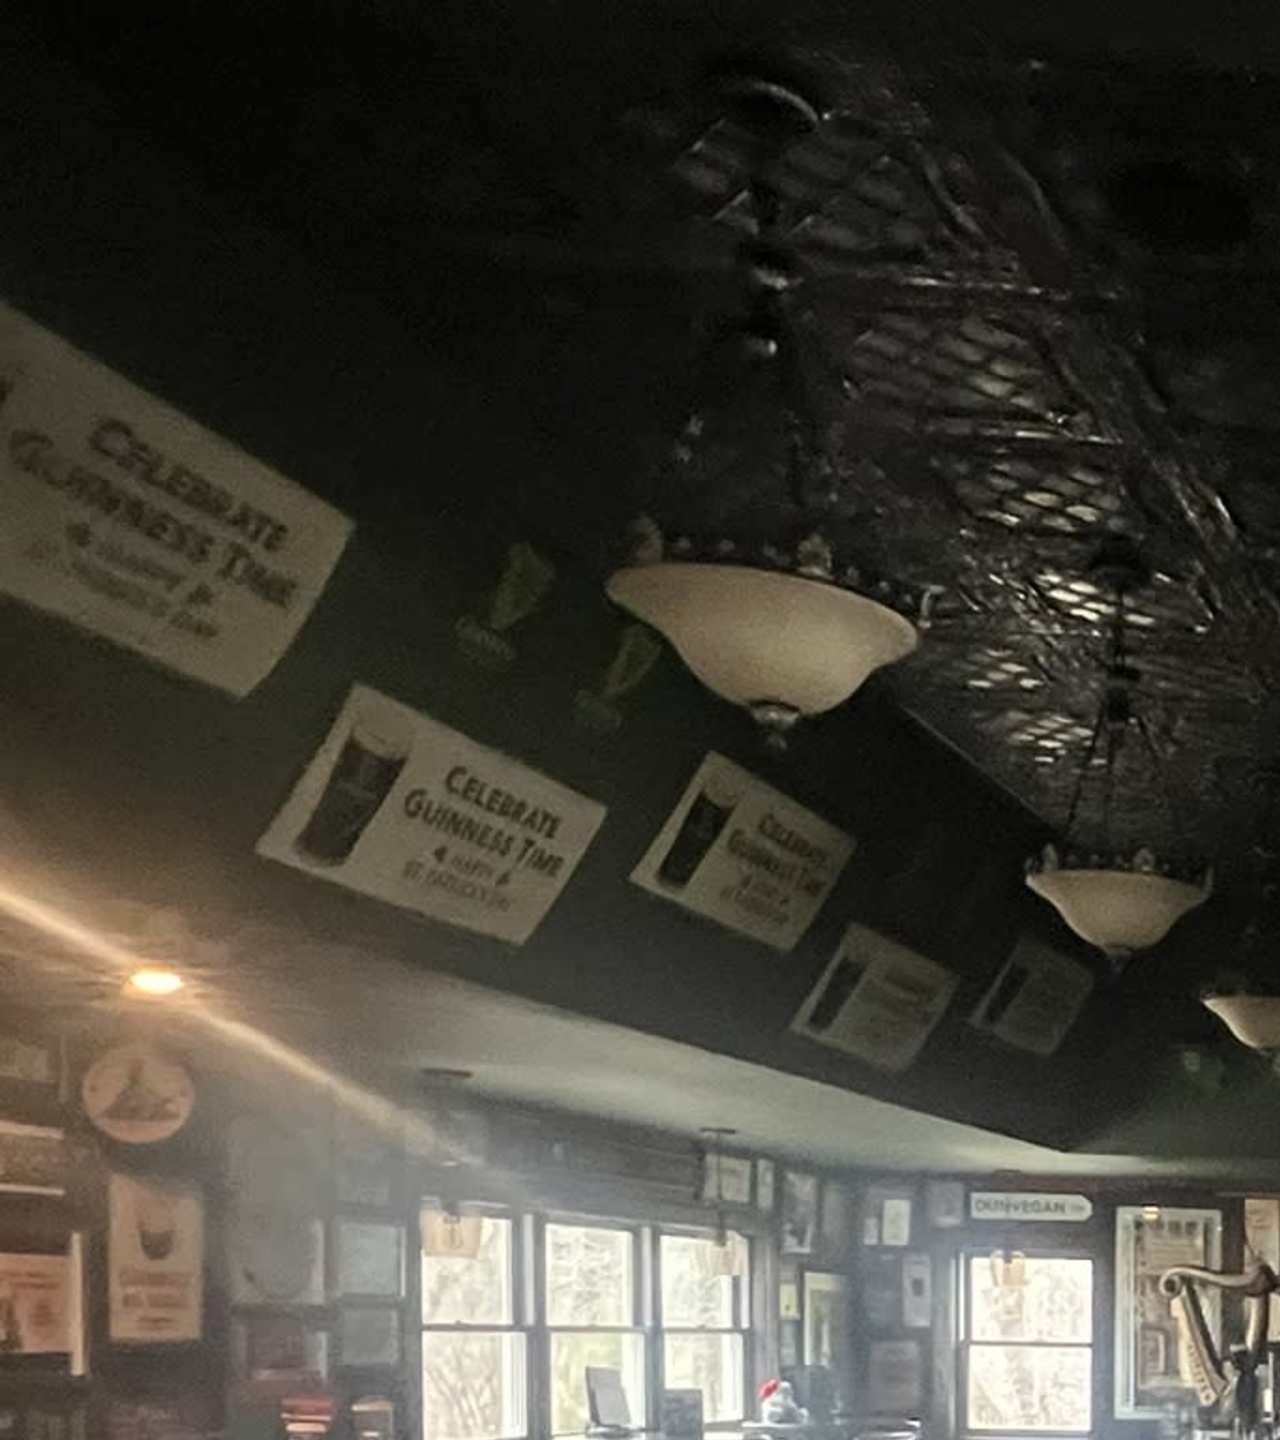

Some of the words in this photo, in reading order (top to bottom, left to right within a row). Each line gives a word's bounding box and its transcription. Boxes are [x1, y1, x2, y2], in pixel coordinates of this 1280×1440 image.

[89, 416, 288, 552] CELEBRATE
[403, 787, 515, 857] GUINNESS
[516, 837, 565, 878] TIME
[445, 765, 562, 839] CELEBRATE
